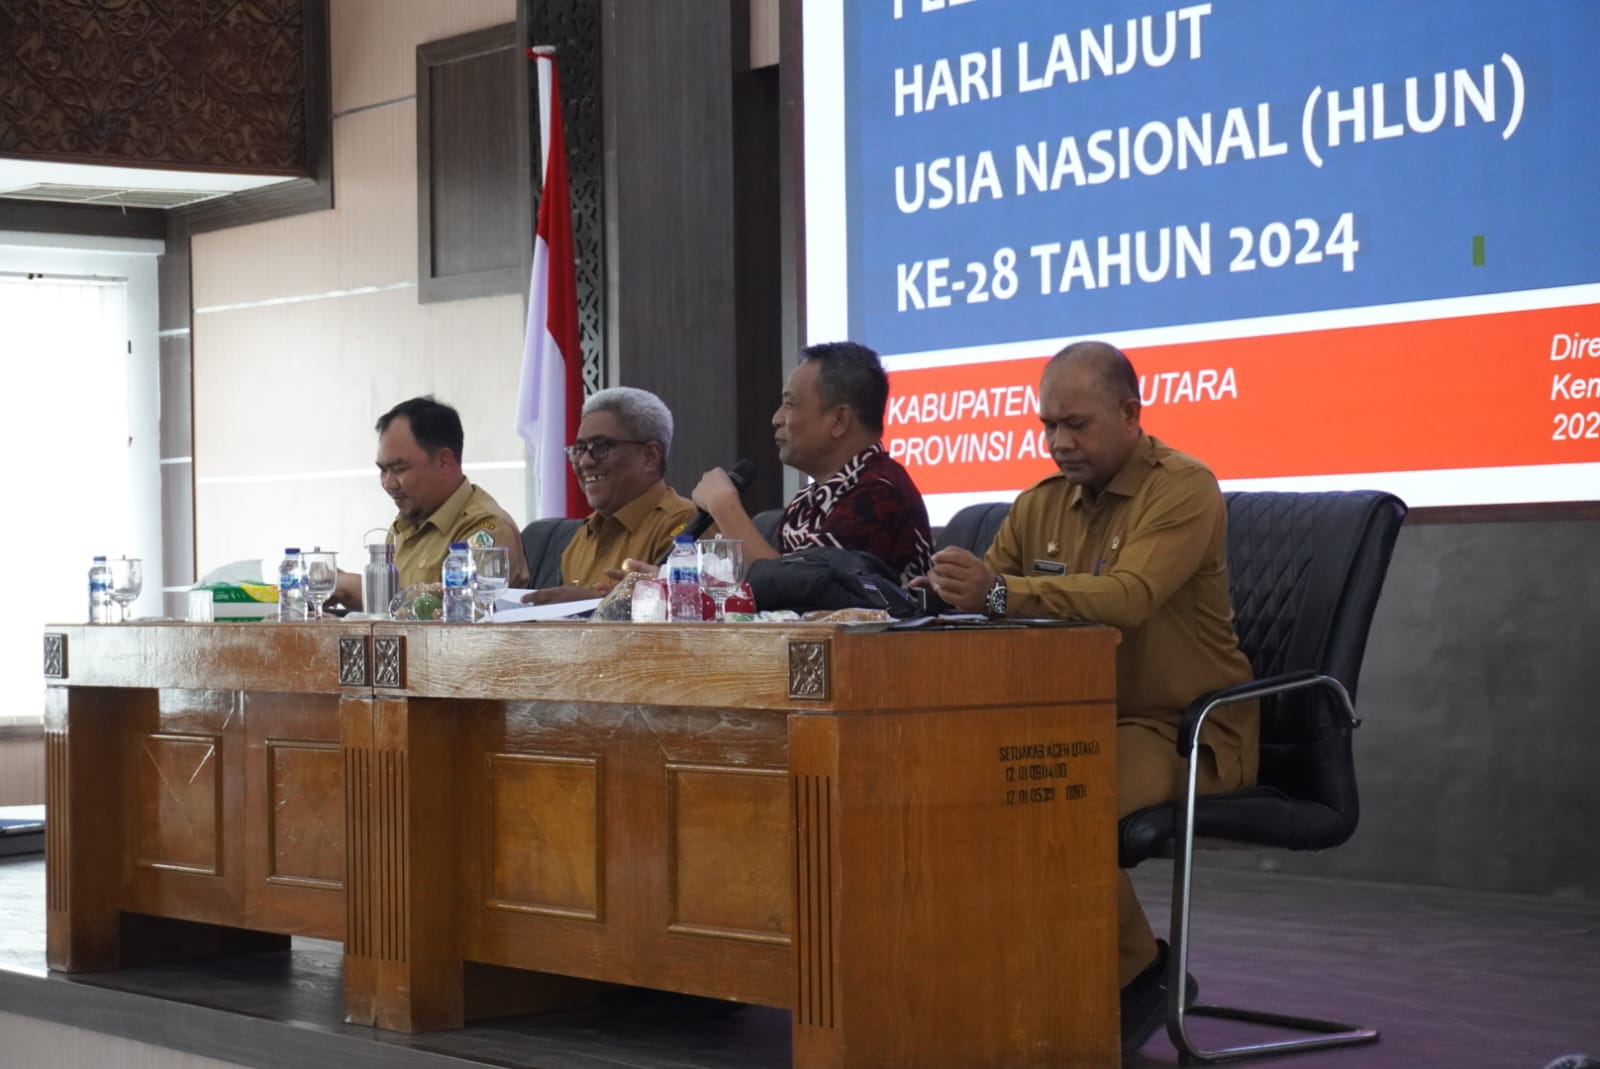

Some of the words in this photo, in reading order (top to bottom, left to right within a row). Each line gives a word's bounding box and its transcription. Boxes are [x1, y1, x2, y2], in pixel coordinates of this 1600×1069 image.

[895, 47, 1002, 117] HARI
[1018, 2, 1212, 93] LANJUT
[895, 150, 1003, 214] USIA
[1015, 102, 1288, 196] NASIONAL
[1302, 52, 1525, 168] (HLUN)
[897, 247, 1019, 312] KE-28
[1030, 222, 1212, 295] TAHUN
[1229, 212, 1360, 273] 2024
[887, 385, 1041, 426] KABUPATEN
[1138, 367, 1238, 407] UTARA
[889, 430, 1014, 467] PROVINSI
